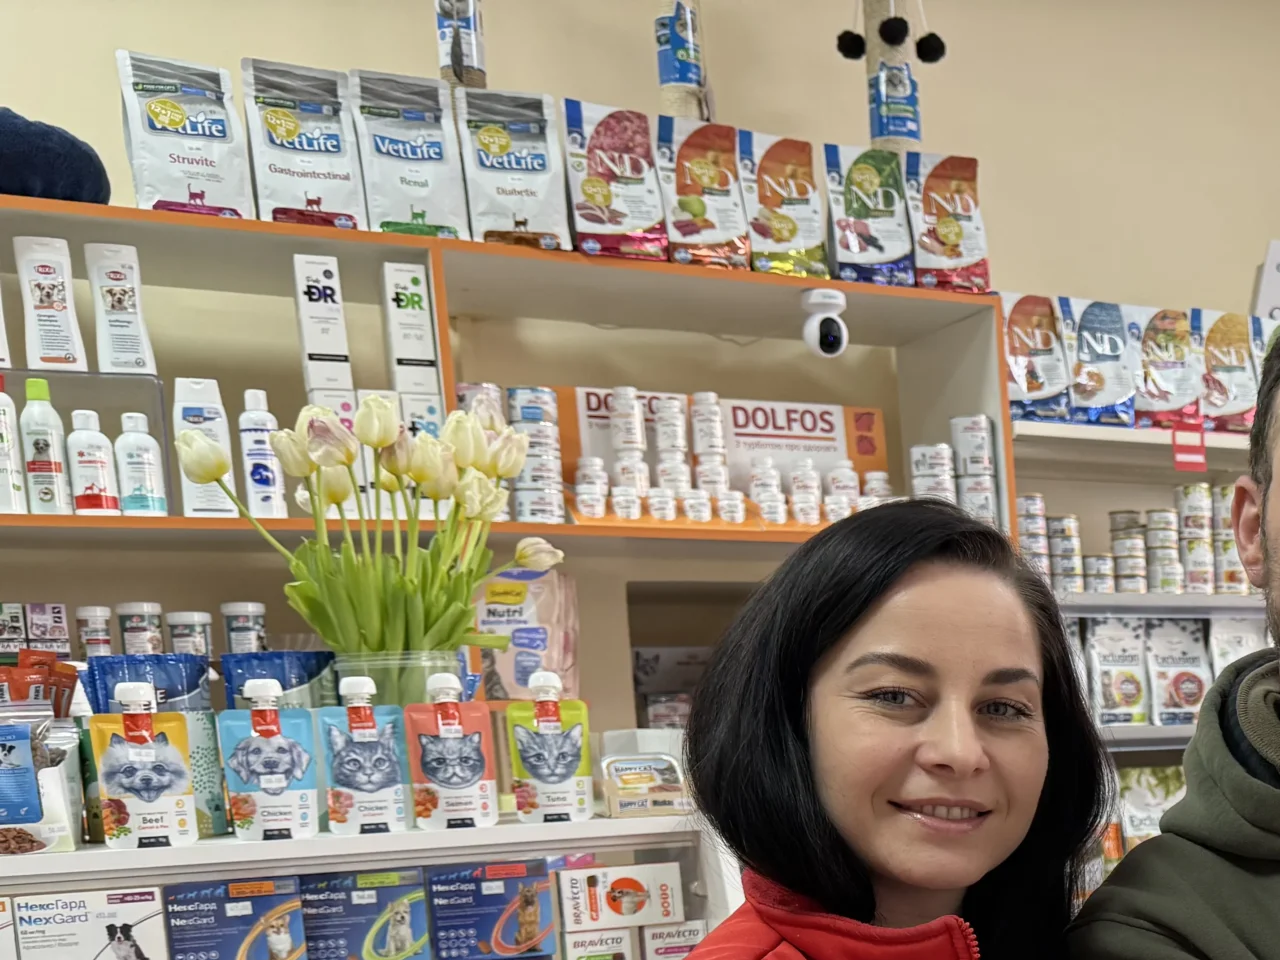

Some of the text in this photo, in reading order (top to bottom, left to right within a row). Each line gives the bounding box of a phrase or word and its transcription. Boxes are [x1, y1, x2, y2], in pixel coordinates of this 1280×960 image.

[375, 137, 440, 159] VetLife
[169, 154, 216, 168] Struvite
[480, 152, 543, 171] VetLife
[268, 164, 351, 182] Gastrointestinal
[732, 405, 836, 438] DOLFOS
[487, 607, 523, 618] Nutri
[546, 795, 567, 803] Tuna
[261, 809, 292, 818] Chicken
[358, 804, 388, 812] Chicken
[142, 816, 164, 825] Beef
[17, 898, 87, 913] НексГард
[570, 877, 583, 926] BRAVECTO
[19, 911, 90, 927] NexGard
[171, 915, 216, 927] NexGard
[573, 933, 624, 951] BRAVECTO
[652, 928, 700, 943] BRAVECTO
